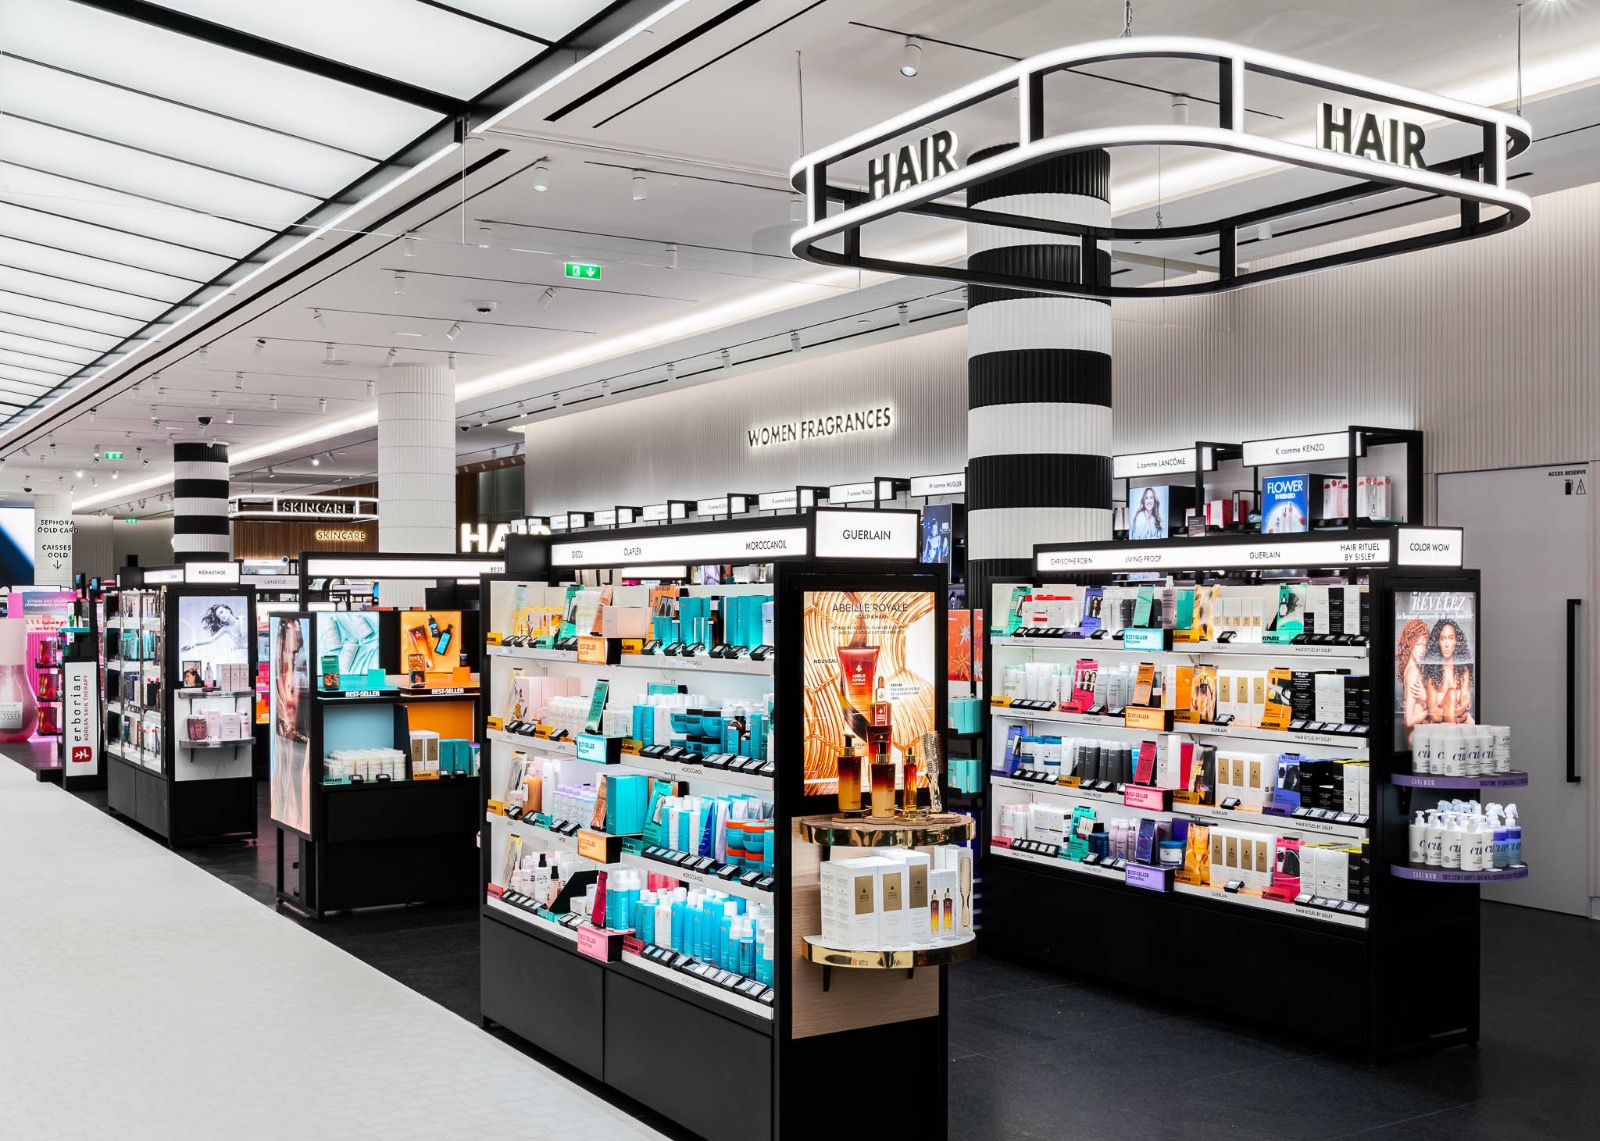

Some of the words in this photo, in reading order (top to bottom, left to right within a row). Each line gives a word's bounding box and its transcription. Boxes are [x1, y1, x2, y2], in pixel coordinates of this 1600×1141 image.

[1317, 103, 1427, 170] HAIR
[868, 130, 957, 200] HAIR
[748, 423, 796, 447] WOMEN
[801, 407, 891, 439] FRAGRANCES
[1302, 444, 1325, 453] KENZO
[1158, 457, 1186, 467] LANCÔME
[1267, 481, 1303, 494] FLOWER
[317, 531, 366, 540] SKINCARE
[842, 529, 891, 541] GUERLAIN
[745, 540, 787, 551] MOROCCANOIL
[1358, 543, 1380, 551] RITUEL
[1409, 543, 1430, 551] COLOR
[1432, 543, 1450, 551] WOW
[1125, 556, 1142, 564] LIVING
[1143, 555, 1162, 563] PROOF
[1249, 551, 1281, 559] GUERLAIN
[1354, 553, 1375, 561] SISLEY
[1411, 592, 1466, 611] RÉVÉLEZ
[833, 603, 870, 613] ABEILLE
[872, 603, 908, 612] ROYALE
[345, 690, 380, 698] BEST-SELLER
[431, 687, 464, 695] BEST-SELLER
[71, 675, 81, 742] erborian
